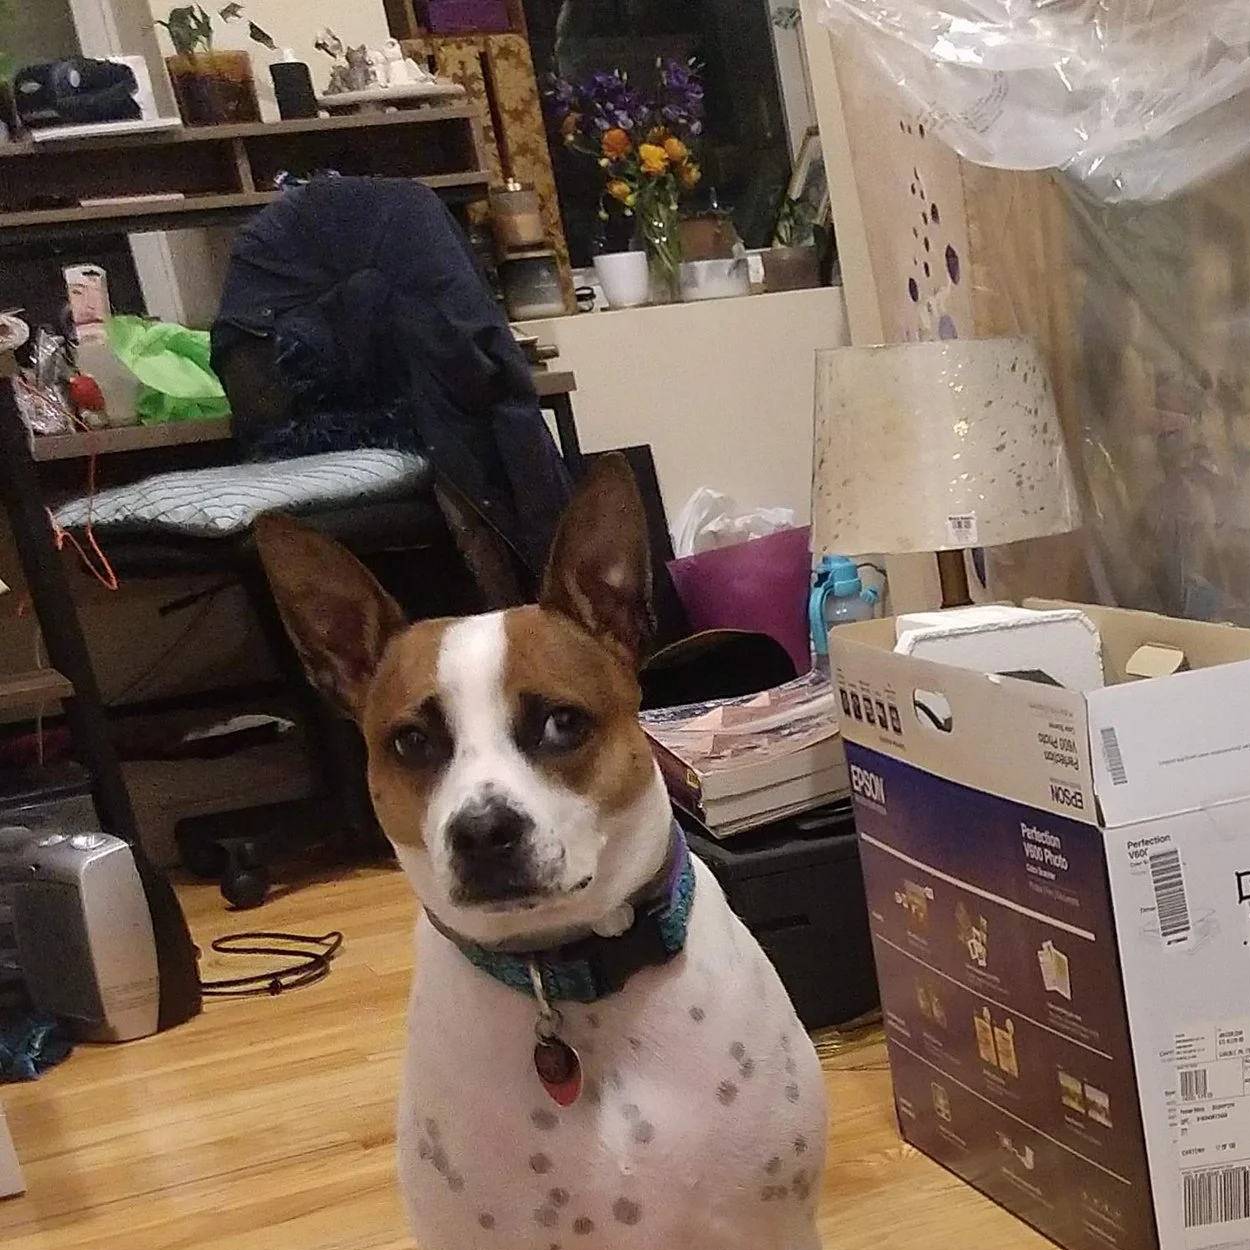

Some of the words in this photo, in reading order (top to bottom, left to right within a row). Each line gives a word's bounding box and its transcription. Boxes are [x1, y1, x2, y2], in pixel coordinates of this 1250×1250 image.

[1043, 750, 1078, 770] Perfection
[851, 765, 885, 804] EPSON
[1050, 784, 1083, 809] EPSON
[1021, 822, 1060, 849] Perfection
[1126, 833, 1171, 849] Perfection
[1044, 848, 1069, 870] Photo
